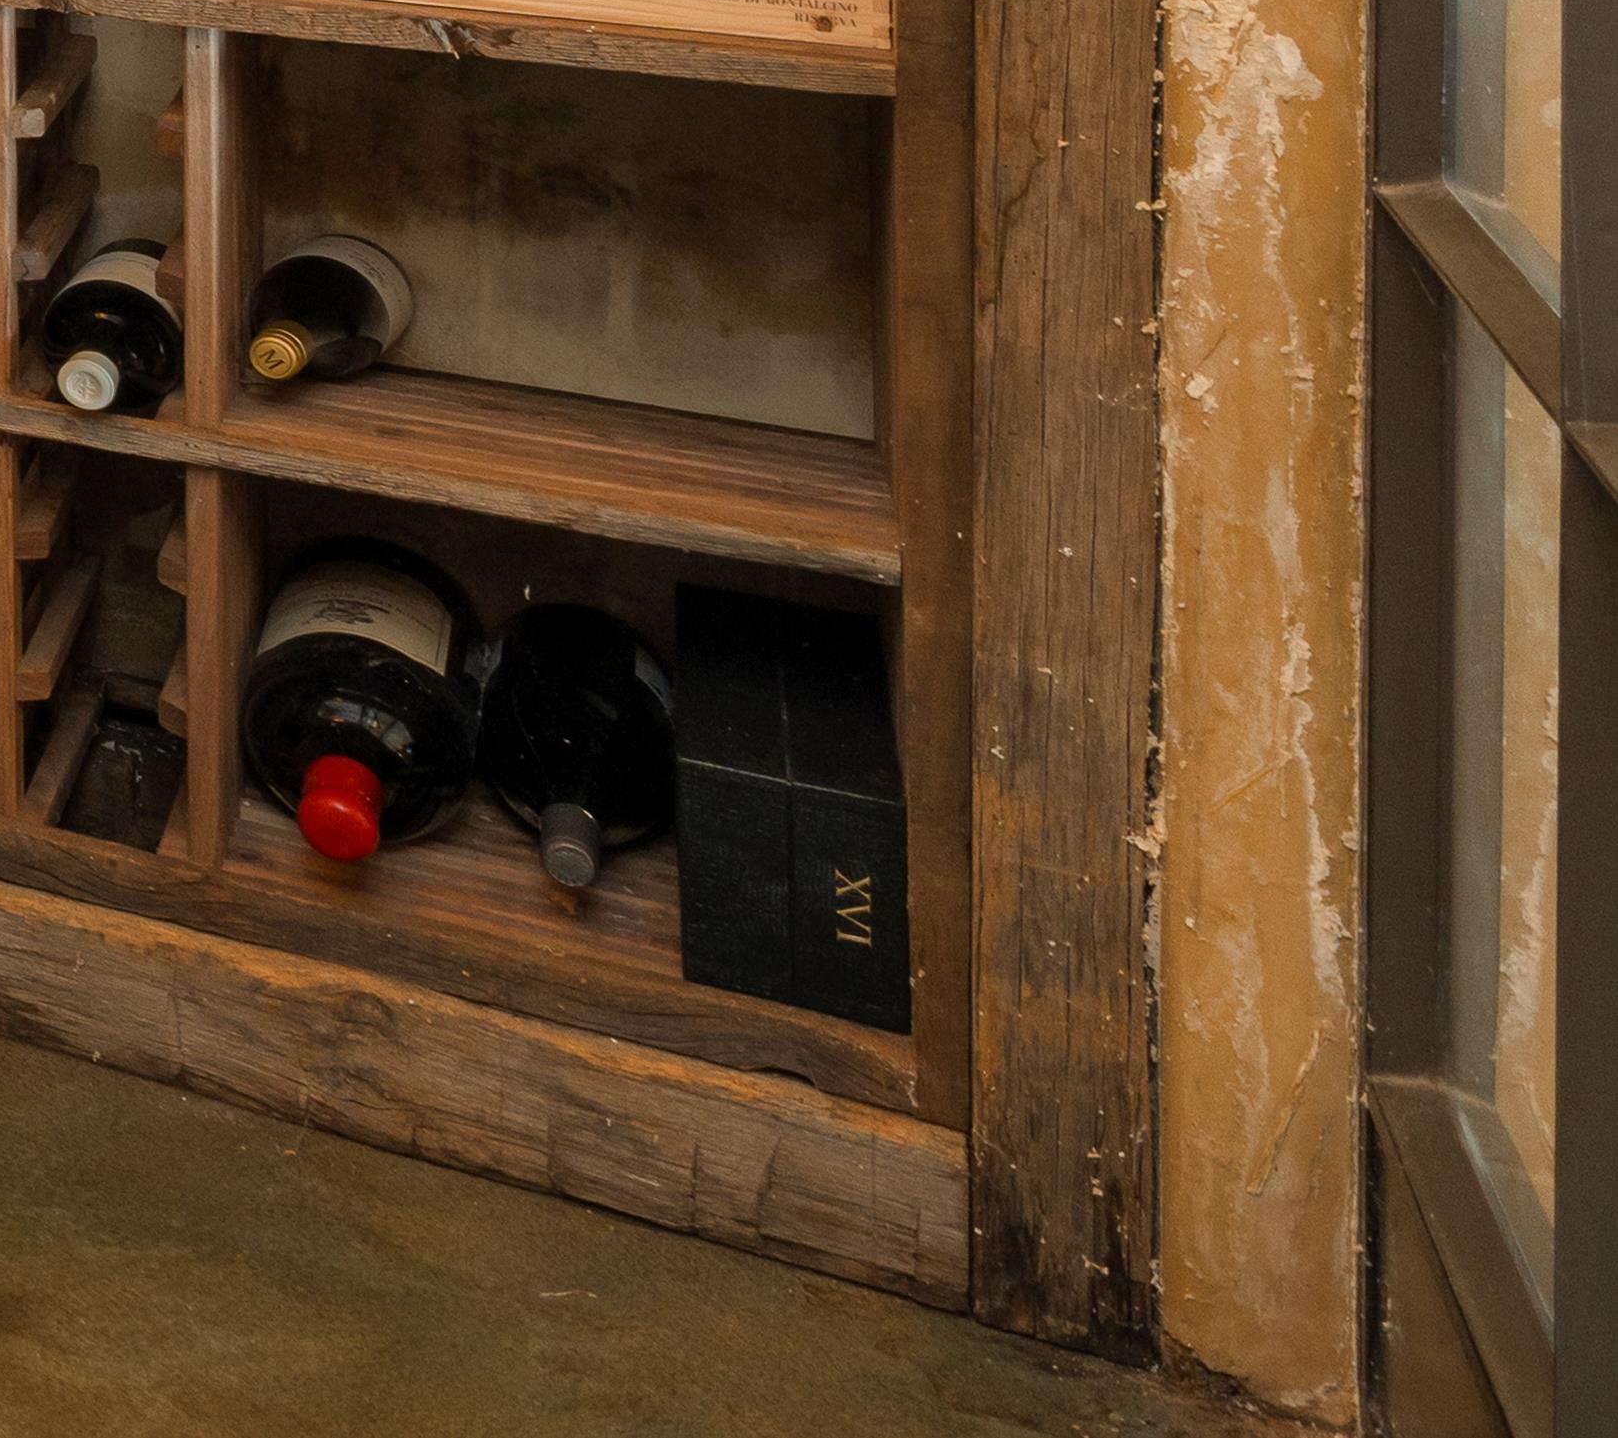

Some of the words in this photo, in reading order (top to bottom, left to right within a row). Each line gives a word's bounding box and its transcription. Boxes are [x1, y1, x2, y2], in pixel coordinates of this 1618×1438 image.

[794, 12, 857, 27] RISVA
[257, 347, 285, 372] M
[833, 868, 876, 947] XVI
